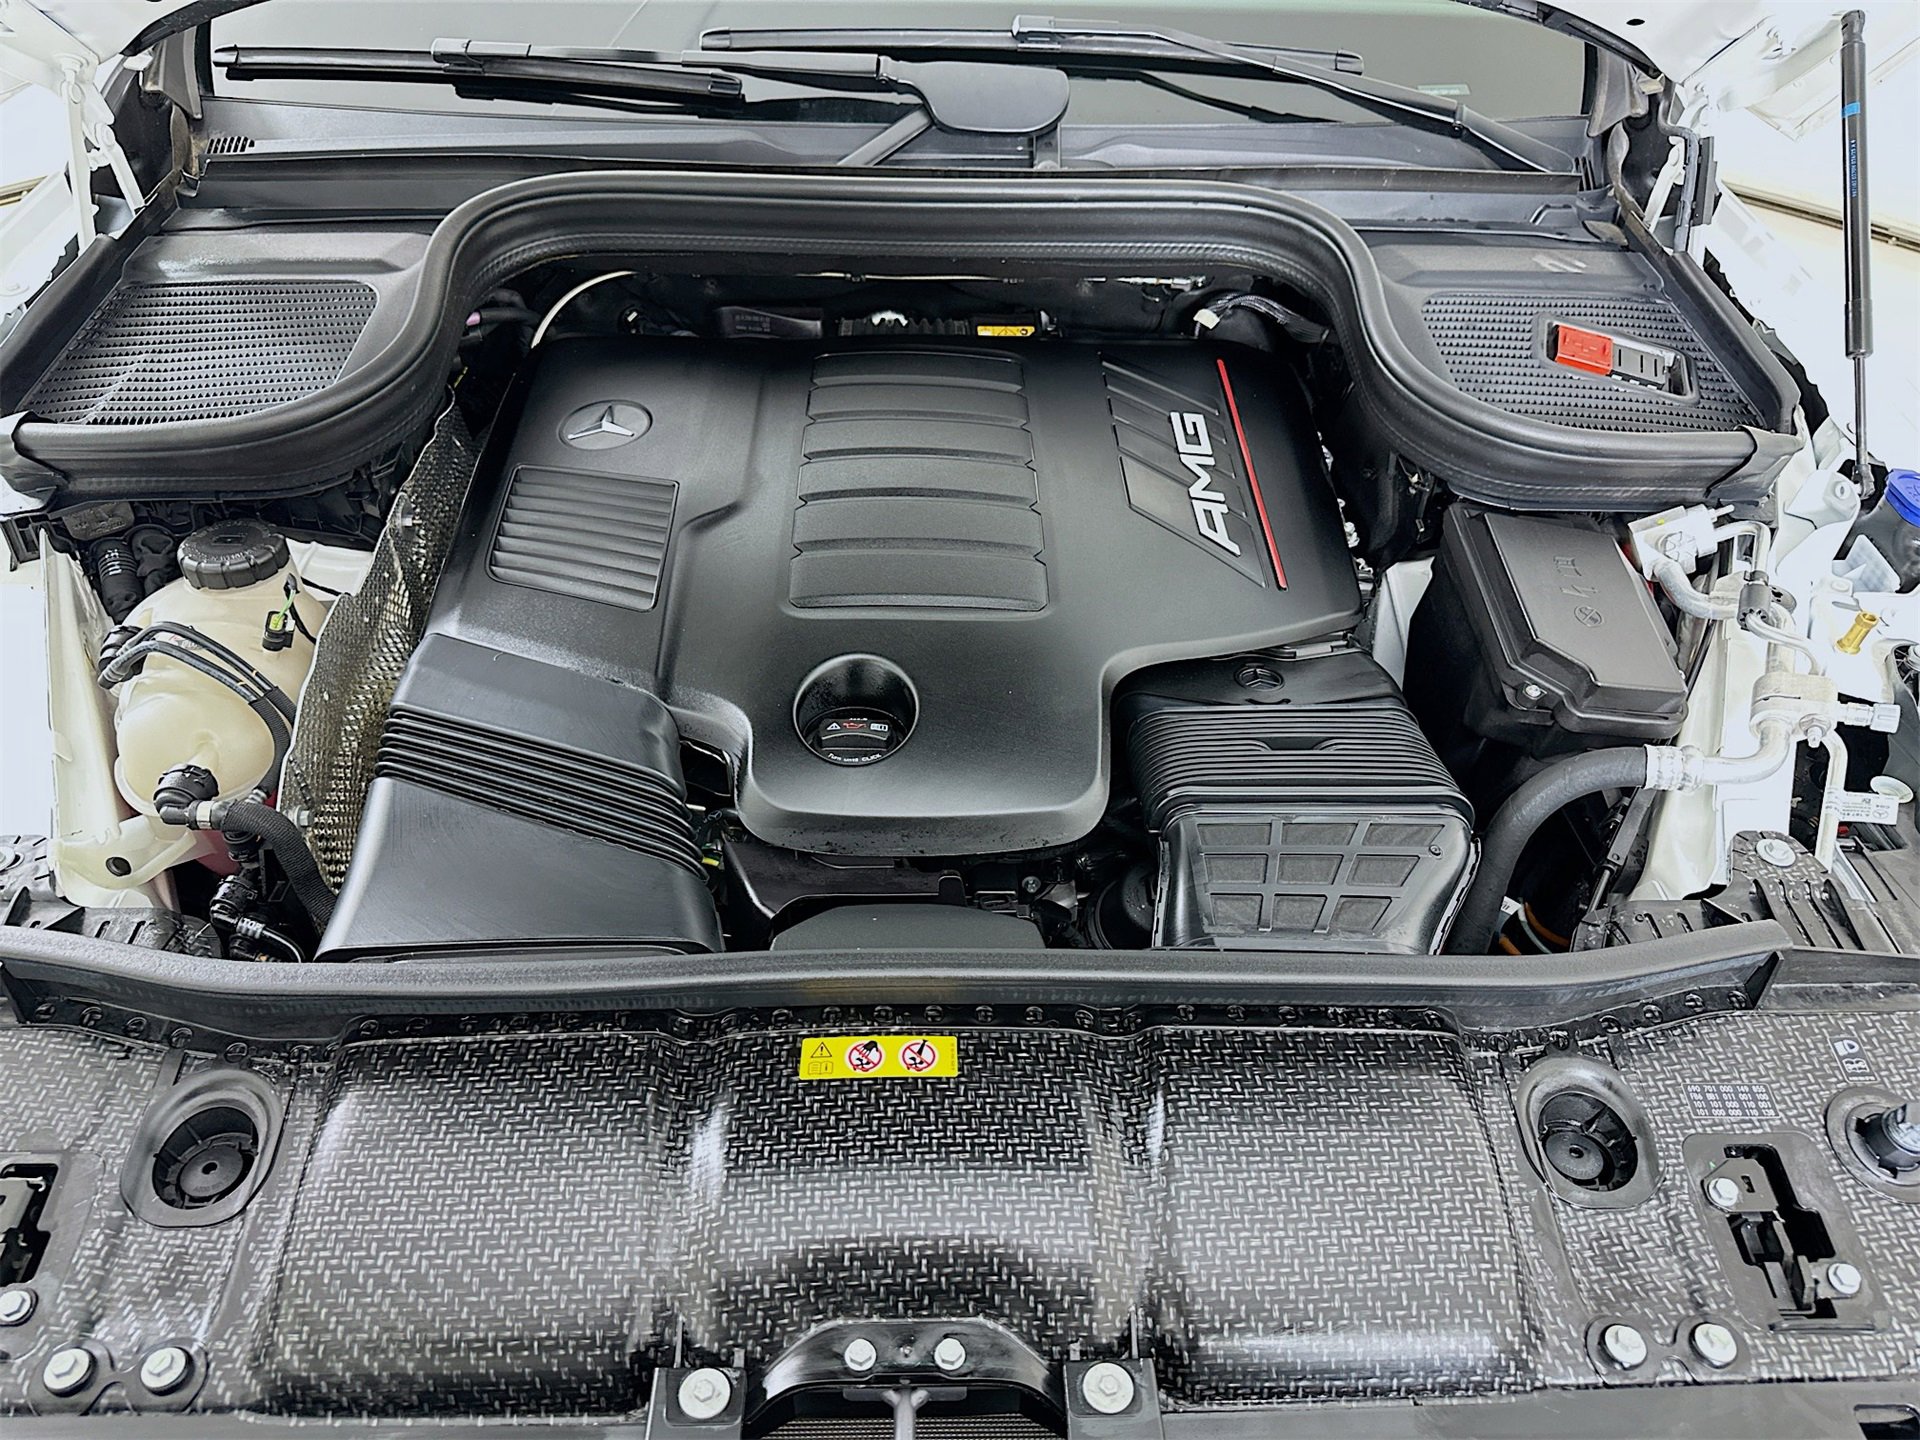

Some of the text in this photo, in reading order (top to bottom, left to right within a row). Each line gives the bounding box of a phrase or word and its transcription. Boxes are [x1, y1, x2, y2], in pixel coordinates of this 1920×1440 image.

[1169, 411, 1242, 556] AMG
[828, 753, 841, 761] Turn
[861, 753, 882, 761] CLICK
[1703, 1085, 1717, 1093] 701
[1719, 1085, 1733, 1093] 000
[1736, 1085, 1749, 1093] 149
[1722, 1093, 1736, 1101] 011
[1738, 1093, 1752, 1101] 001
[1755, 1093, 1769, 1101] 100
[1693, 1101, 1772, 1109] 101 101 000 110 001
